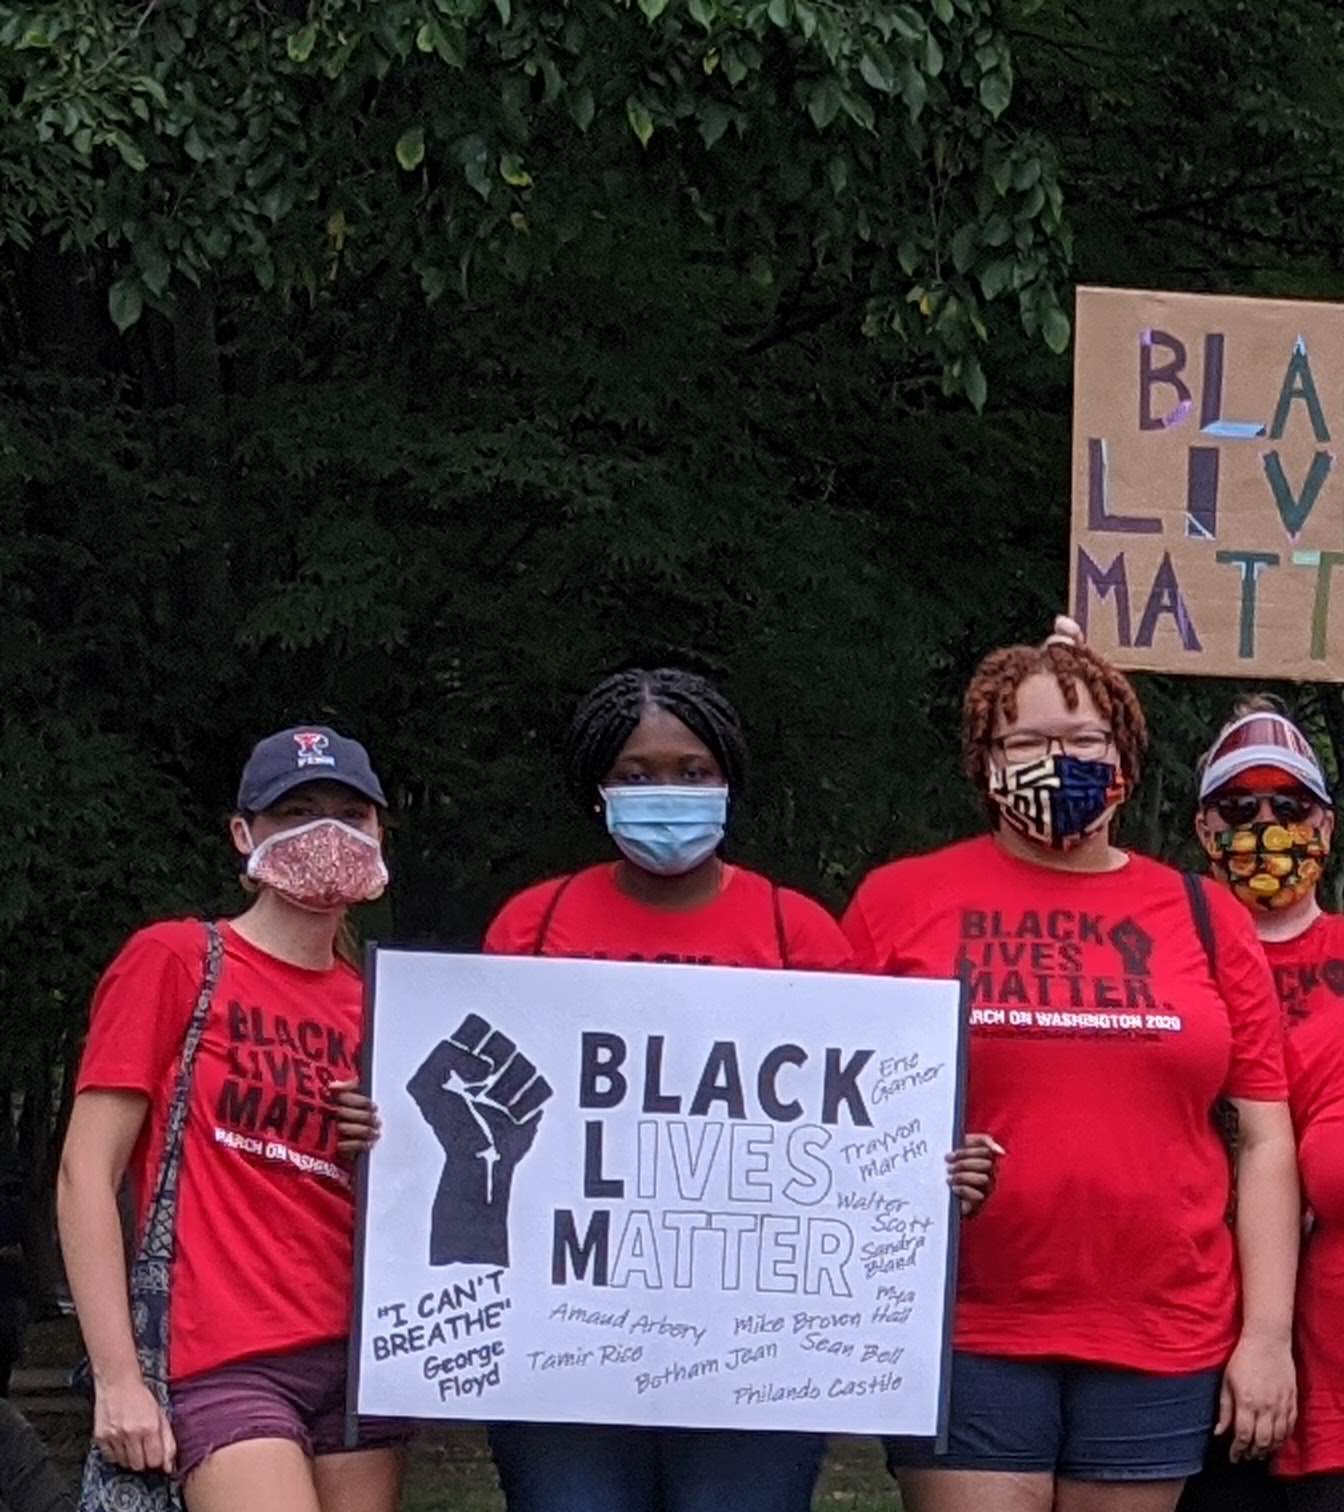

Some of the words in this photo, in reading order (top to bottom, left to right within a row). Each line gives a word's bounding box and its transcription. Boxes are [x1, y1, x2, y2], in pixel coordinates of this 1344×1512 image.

[960, 910, 1104, 944] BLACK
[955, 942, 1083, 975] LIVES
[228, 1001, 350, 1070] BLACK
[970, 1008, 1004, 1025] RCH
[1010, 1010, 1032, 1028] ON
[1036, 1011, 1142, 1030] WASHINGTON
[1145, 1015, 1182, 1031] 2020
[578, 1031, 876, 1128] BLACK
[880, 1053, 919, 1077] Eric
[872, 1063, 945, 1104] Garner
[215, 1079, 338, 1158] MATT
[214, 1127, 262, 1155] MARCH
[840, 1118, 921, 1164] Trayvon
[584, 1119, 834, 1206] LIVES
[837, 1191, 910, 1212] Walter
[871, 1213, 934, 1232] Scott
[552, 1209, 856, 1298] MATTER
[860, 1233, 926, 1261] Sandra
[864, 1249, 916, 1280] Bland
[418, 1270, 505, 1322] CAN'T
[734, 1314, 784, 1335] Mike
[793, 1312, 862, 1334] Brown
[871, 1304, 912, 1324] Hall
[423, 1342, 505, 1380] George
[527, 1347, 594, 1371] Tamir
[800, 1332, 854, 1357] Sean
[860, 1344, 905, 1365] Bell
[438, 1363, 501, 1402] Floyd
[635, 1358, 719, 1395] Botham
[725, 1343, 777, 1370] Jean
[733, 1378, 820, 1405] Philando
